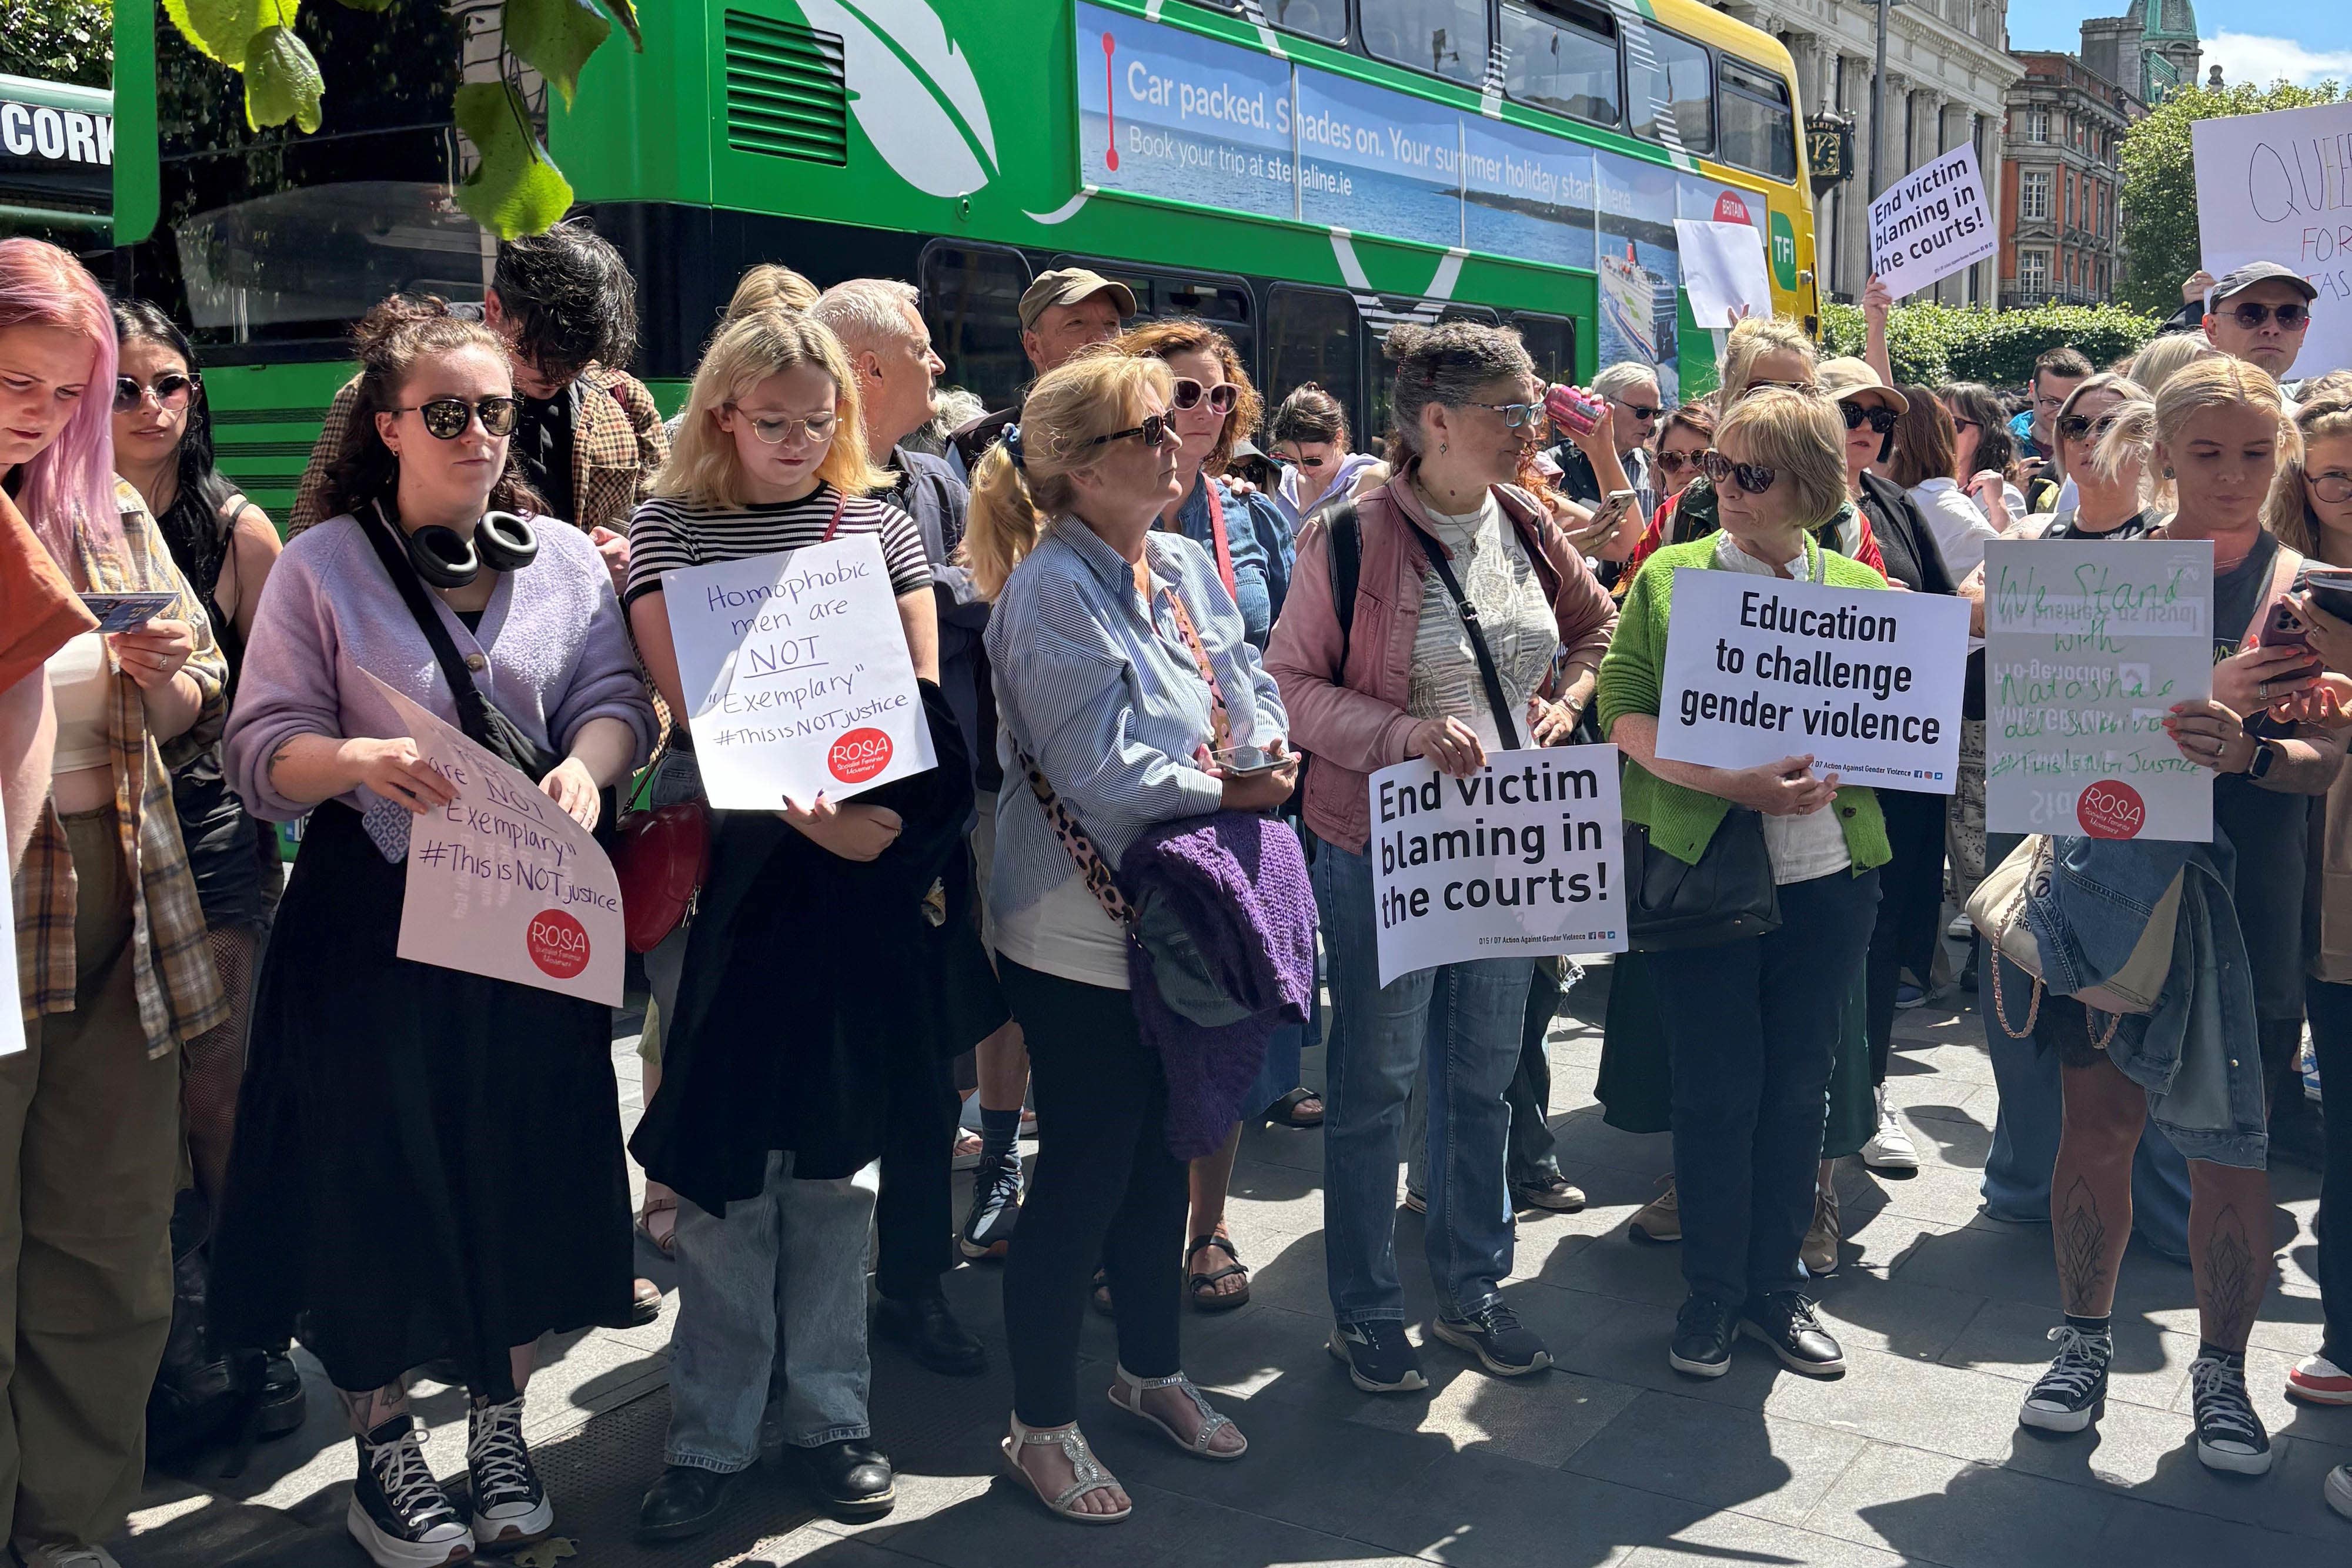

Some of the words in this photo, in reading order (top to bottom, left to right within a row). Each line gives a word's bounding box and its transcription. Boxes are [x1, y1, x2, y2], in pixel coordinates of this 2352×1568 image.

[1, 103, 114, 165] CORK
[1127, 61, 1173, 106] Car
[1180, 83, 1270, 130] packed.
[1276, 98, 1352, 150] Shades
[1355, 128, 1385, 157] on.
[1388, 126, 1431, 167] Your
[1435, 146, 1502, 183] summer
[1505, 155, 1558, 202] holiday
[1130, 125, 1174, 160] Book
[1178, 142, 1214, 168] your
[1220, 145, 1245, 178] trip
[1250, 153, 1264, 178] at
[1268, 157, 1352, 196] stenaline.ie
[2249, 133, 2352, 223] QUEE
[1722, 199, 1744, 220] BRITAIN
[1875, 189, 1902, 227] End
[1906, 159, 1968, 202] victim
[1875, 251, 1905, 278] the
[1910, 206, 1984, 260] courts!
[1876, 198, 1950, 252] blaming
[1953, 186, 1976, 208] in
[1775, 235, 1793, 265] TFI
[707, 560, 870, 611] Homophobic
[1999, 566, 2053, 614] We
[2074, 564, 2183, 615] Stand
[731, 613, 791, 635] men
[810, 600, 848, 620] are
[1740, 591, 1897, 643] Education
[2055, 618, 2125, 653] with
[751, 636, 820, 673] NOT
[1716, 638, 1745, 674] to
[1756, 646, 1912, 701] challenge
[1681, 688, 1793, 732] gender
[1802, 701, 1940, 744] violence
[429, 757, 468, 785] are
[833, 737, 888, 763] ROSA
[1823, 762, 1842, 770] Action
[1842, 764, 1864, 772] Against
[1865, 765, 1885, 774] Gender
[1886, 767, 1911, 777] Violence
[485, 776, 543, 820] NOT
[1379, 770, 1442, 823] End
[1456, 762, 1598, 806] victim
[2085, 787, 2140, 825] ROSA
[1381, 818, 1545, 877] blaming
[1562, 813, 1602, 851] in
[1381, 885, 1430, 929] the
[1444, 862, 1607, 911] courts!
[532, 921, 586, 952] ROSA
